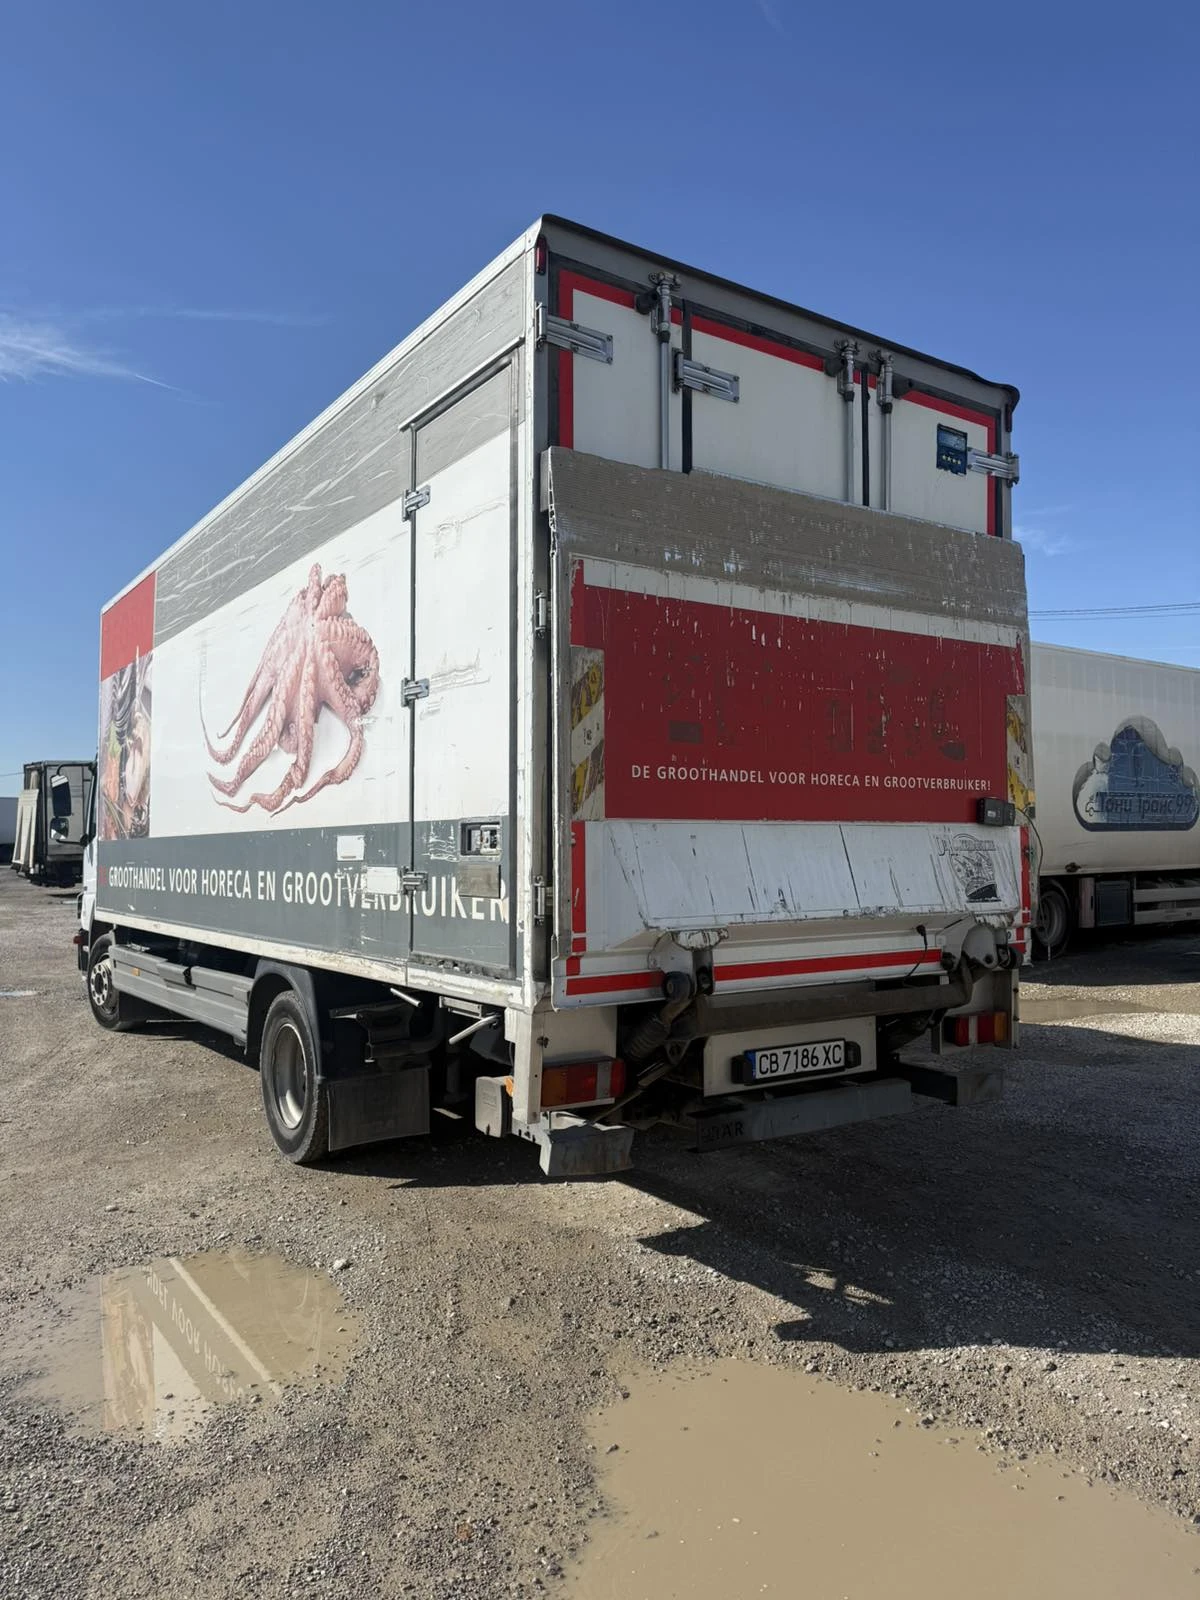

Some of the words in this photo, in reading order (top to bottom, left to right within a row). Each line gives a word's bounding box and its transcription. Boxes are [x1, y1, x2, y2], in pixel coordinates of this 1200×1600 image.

[631, 764, 651, 779] DE
[656, 765, 764, 784] GROOTHANDEL
[769, 770, 806, 785] VOOR
[810, 772, 860, 788] HORECA
[864, 774, 880, 788] EN
[884, 775, 992, 791] GROOTVERBRUIKER!
[108, 865, 166, 891] GROOTHANDEL
[169, 867, 198, 895] VOOR
[201, 868, 252, 900] HORECA
[256, 871, 276, 901] EN
[758, 1052, 779, 1075] CB
[782, 1047, 819, 1072] 7186
[823, 1044, 842, 1066] XC
